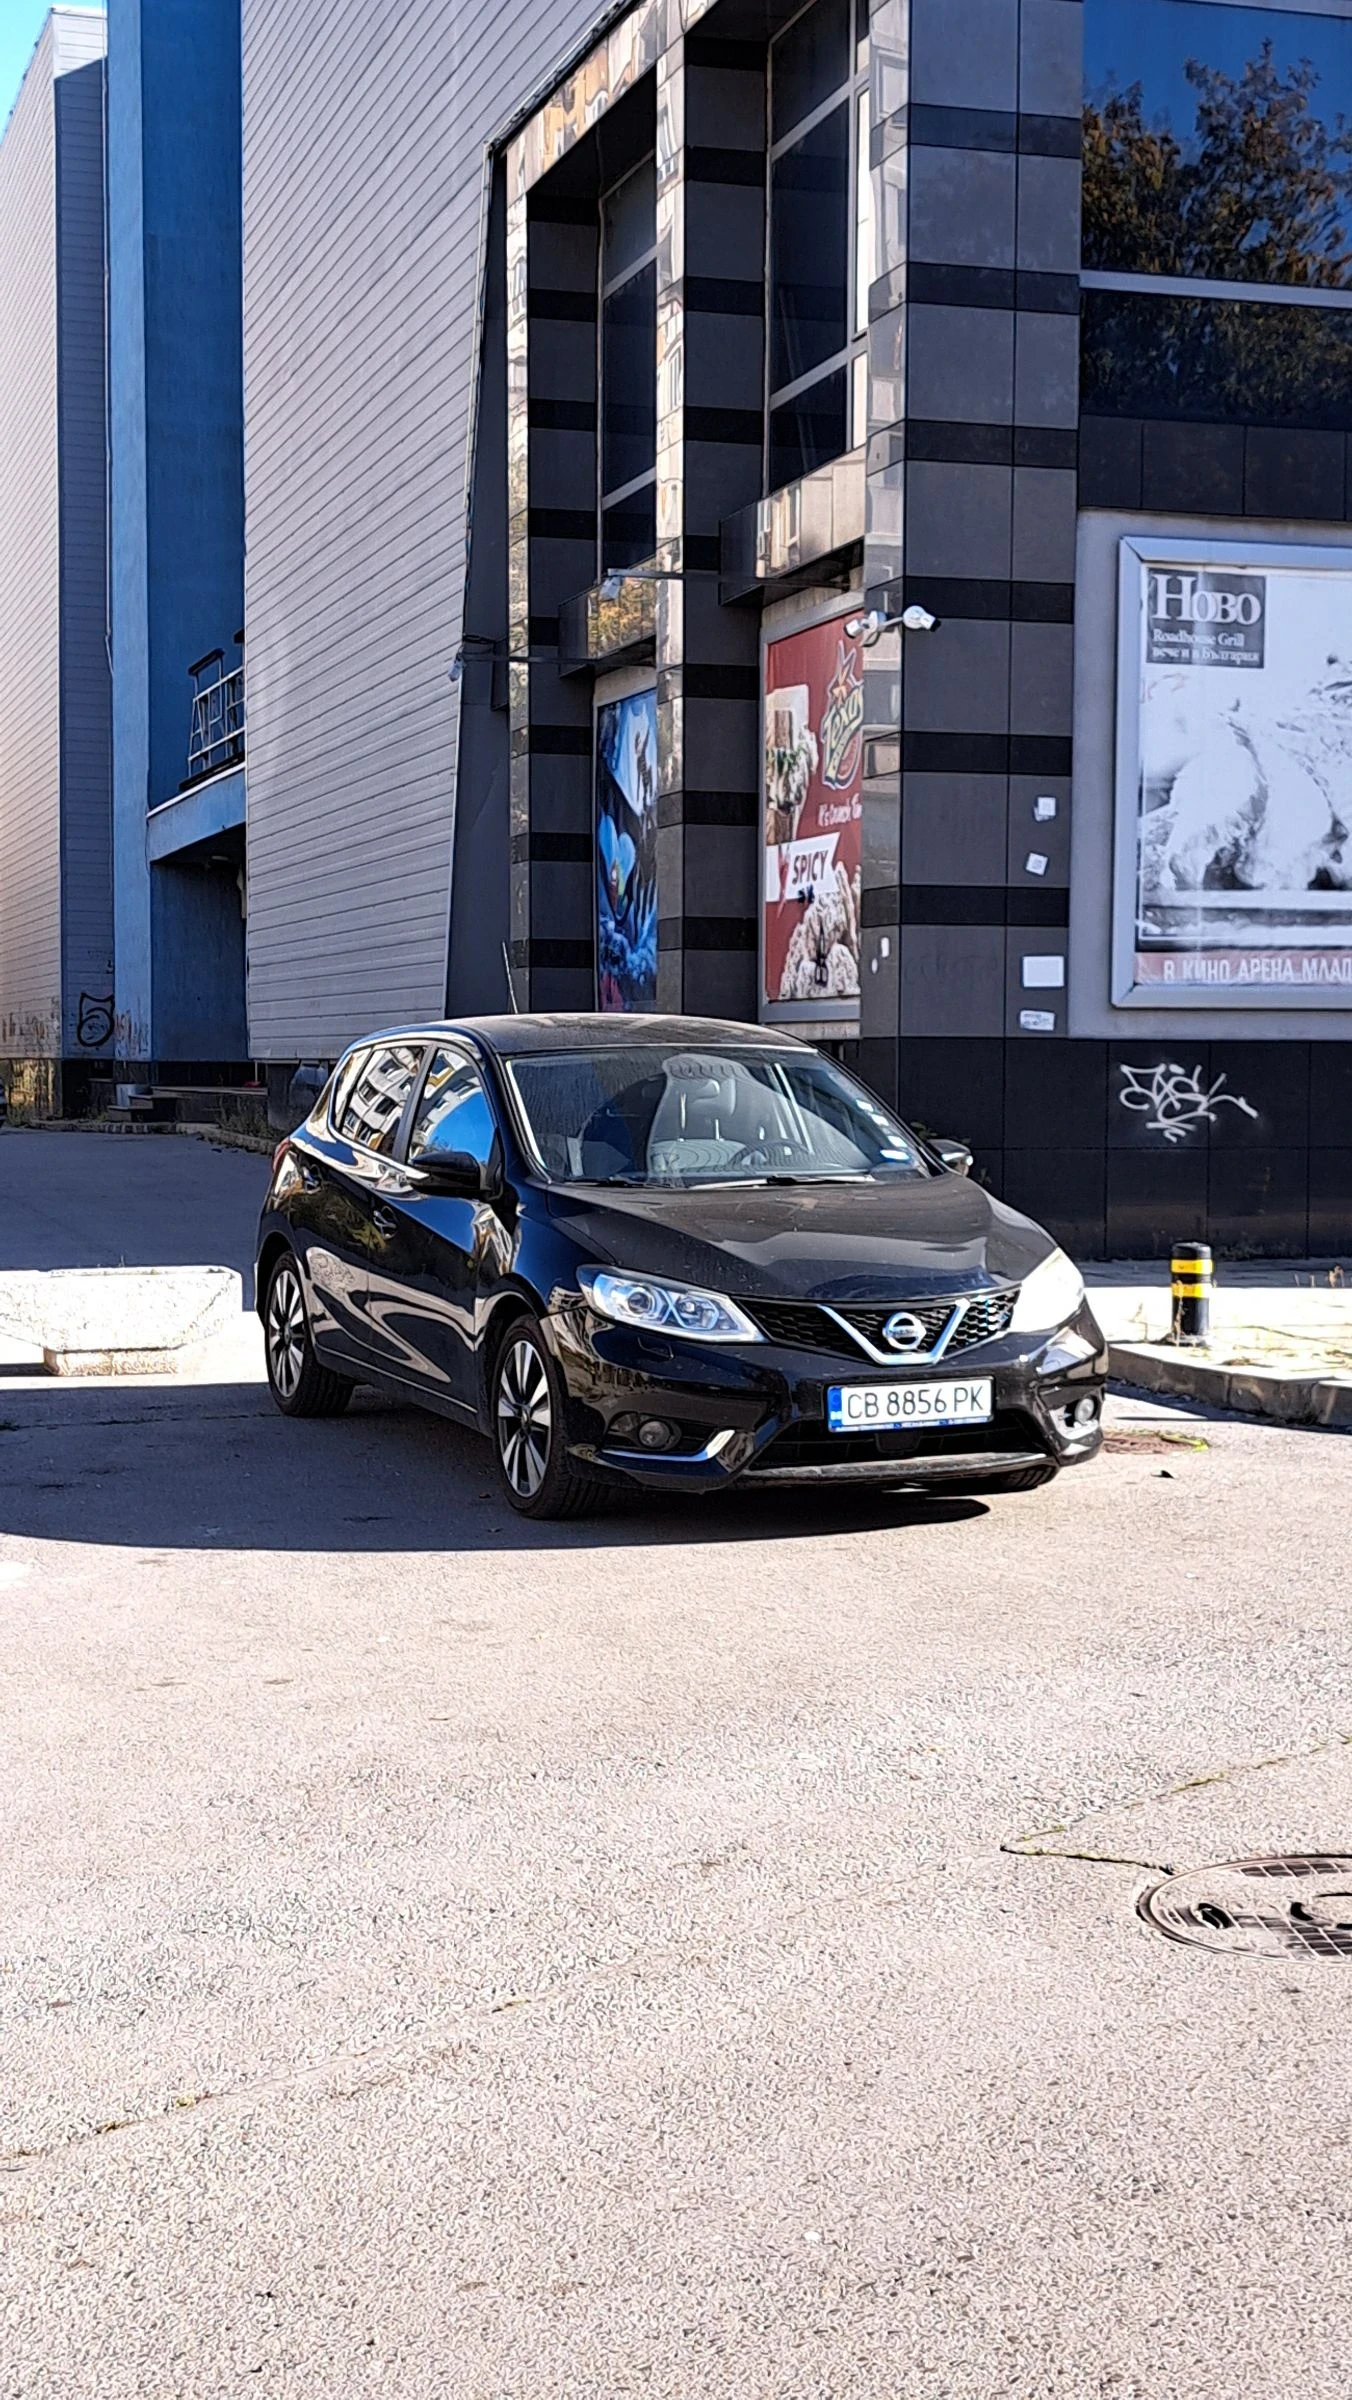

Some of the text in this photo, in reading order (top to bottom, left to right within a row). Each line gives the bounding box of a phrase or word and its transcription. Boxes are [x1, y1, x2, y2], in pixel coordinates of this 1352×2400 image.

[1152, 628, 1245, 647] Roadhouse Grill
[792, 850, 829, 885] SPICY
[1182, 958, 1231, 982] КИНО
[1237, 957, 1295, 982] АРЕНА
[847, 1385, 984, 1419] CB 8856 PK
